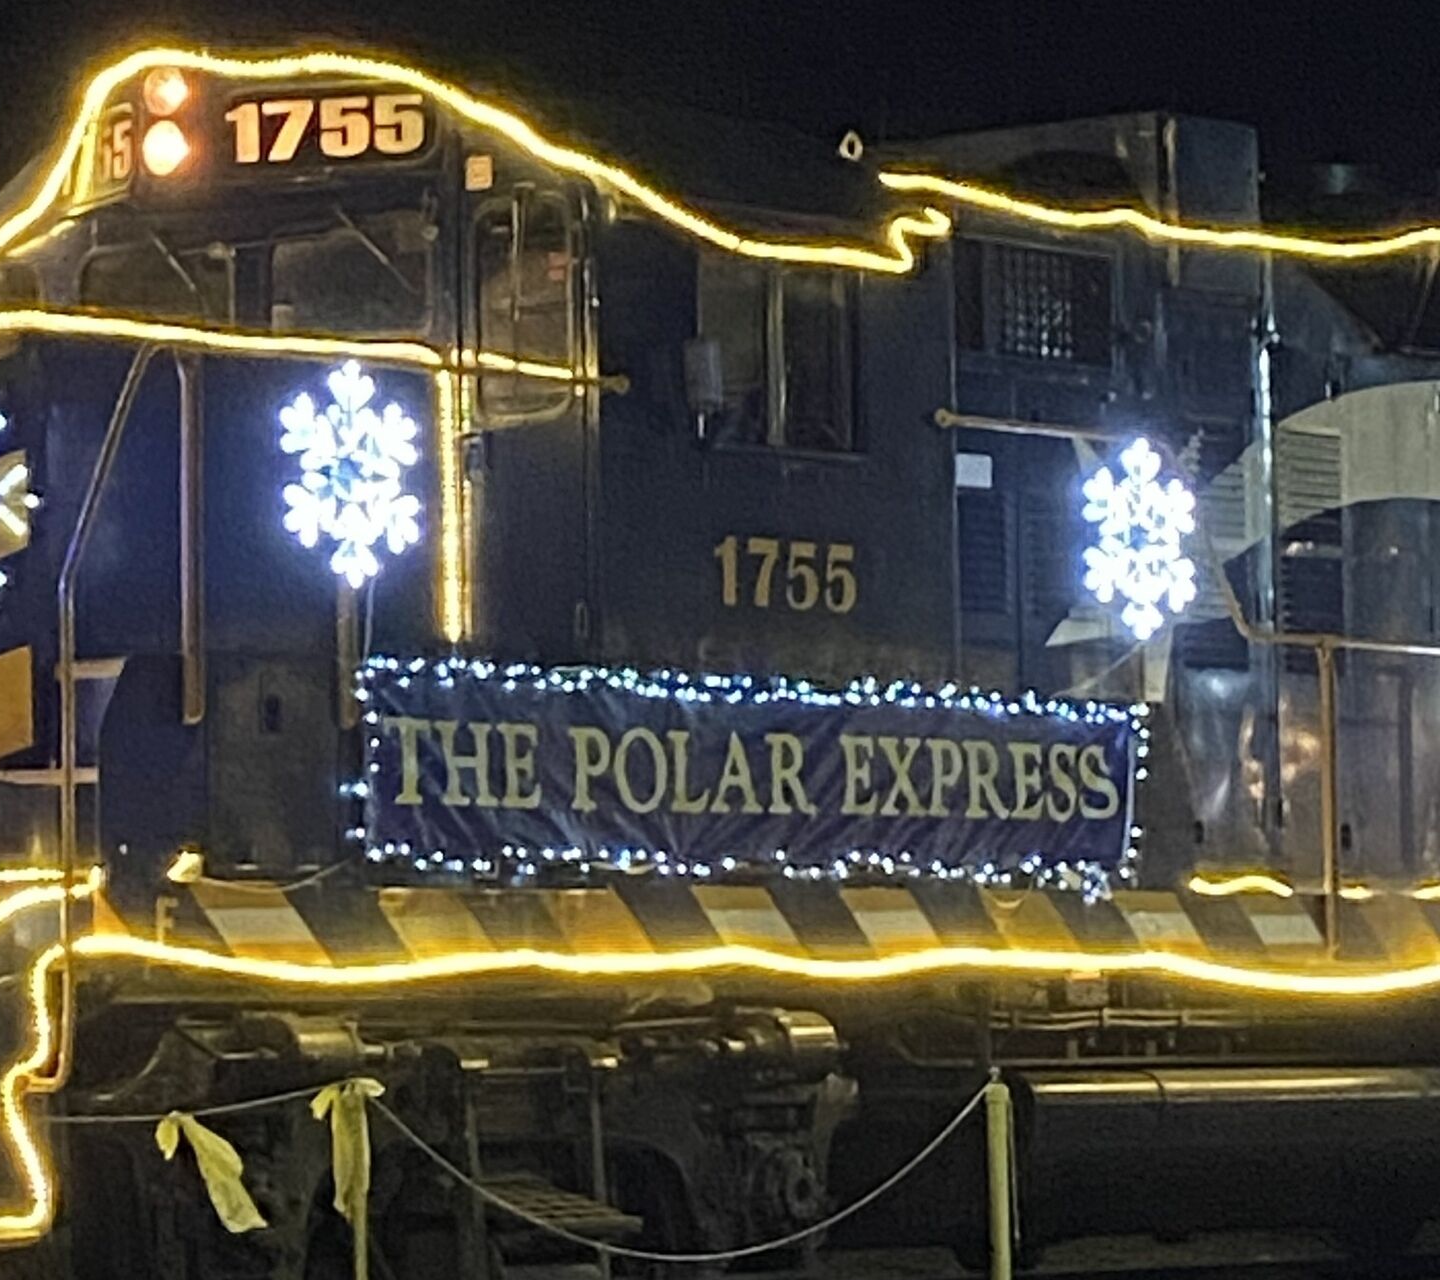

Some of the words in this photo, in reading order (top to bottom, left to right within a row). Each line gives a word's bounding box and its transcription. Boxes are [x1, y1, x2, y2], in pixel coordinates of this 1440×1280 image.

[225, 93, 425, 164] 1755
[714, 535, 858, 614] 1755
[383, 716, 543, 810] THE
[567, 726, 819, 819] POLAR
[839, 733, 1121, 823] EXPRESS
